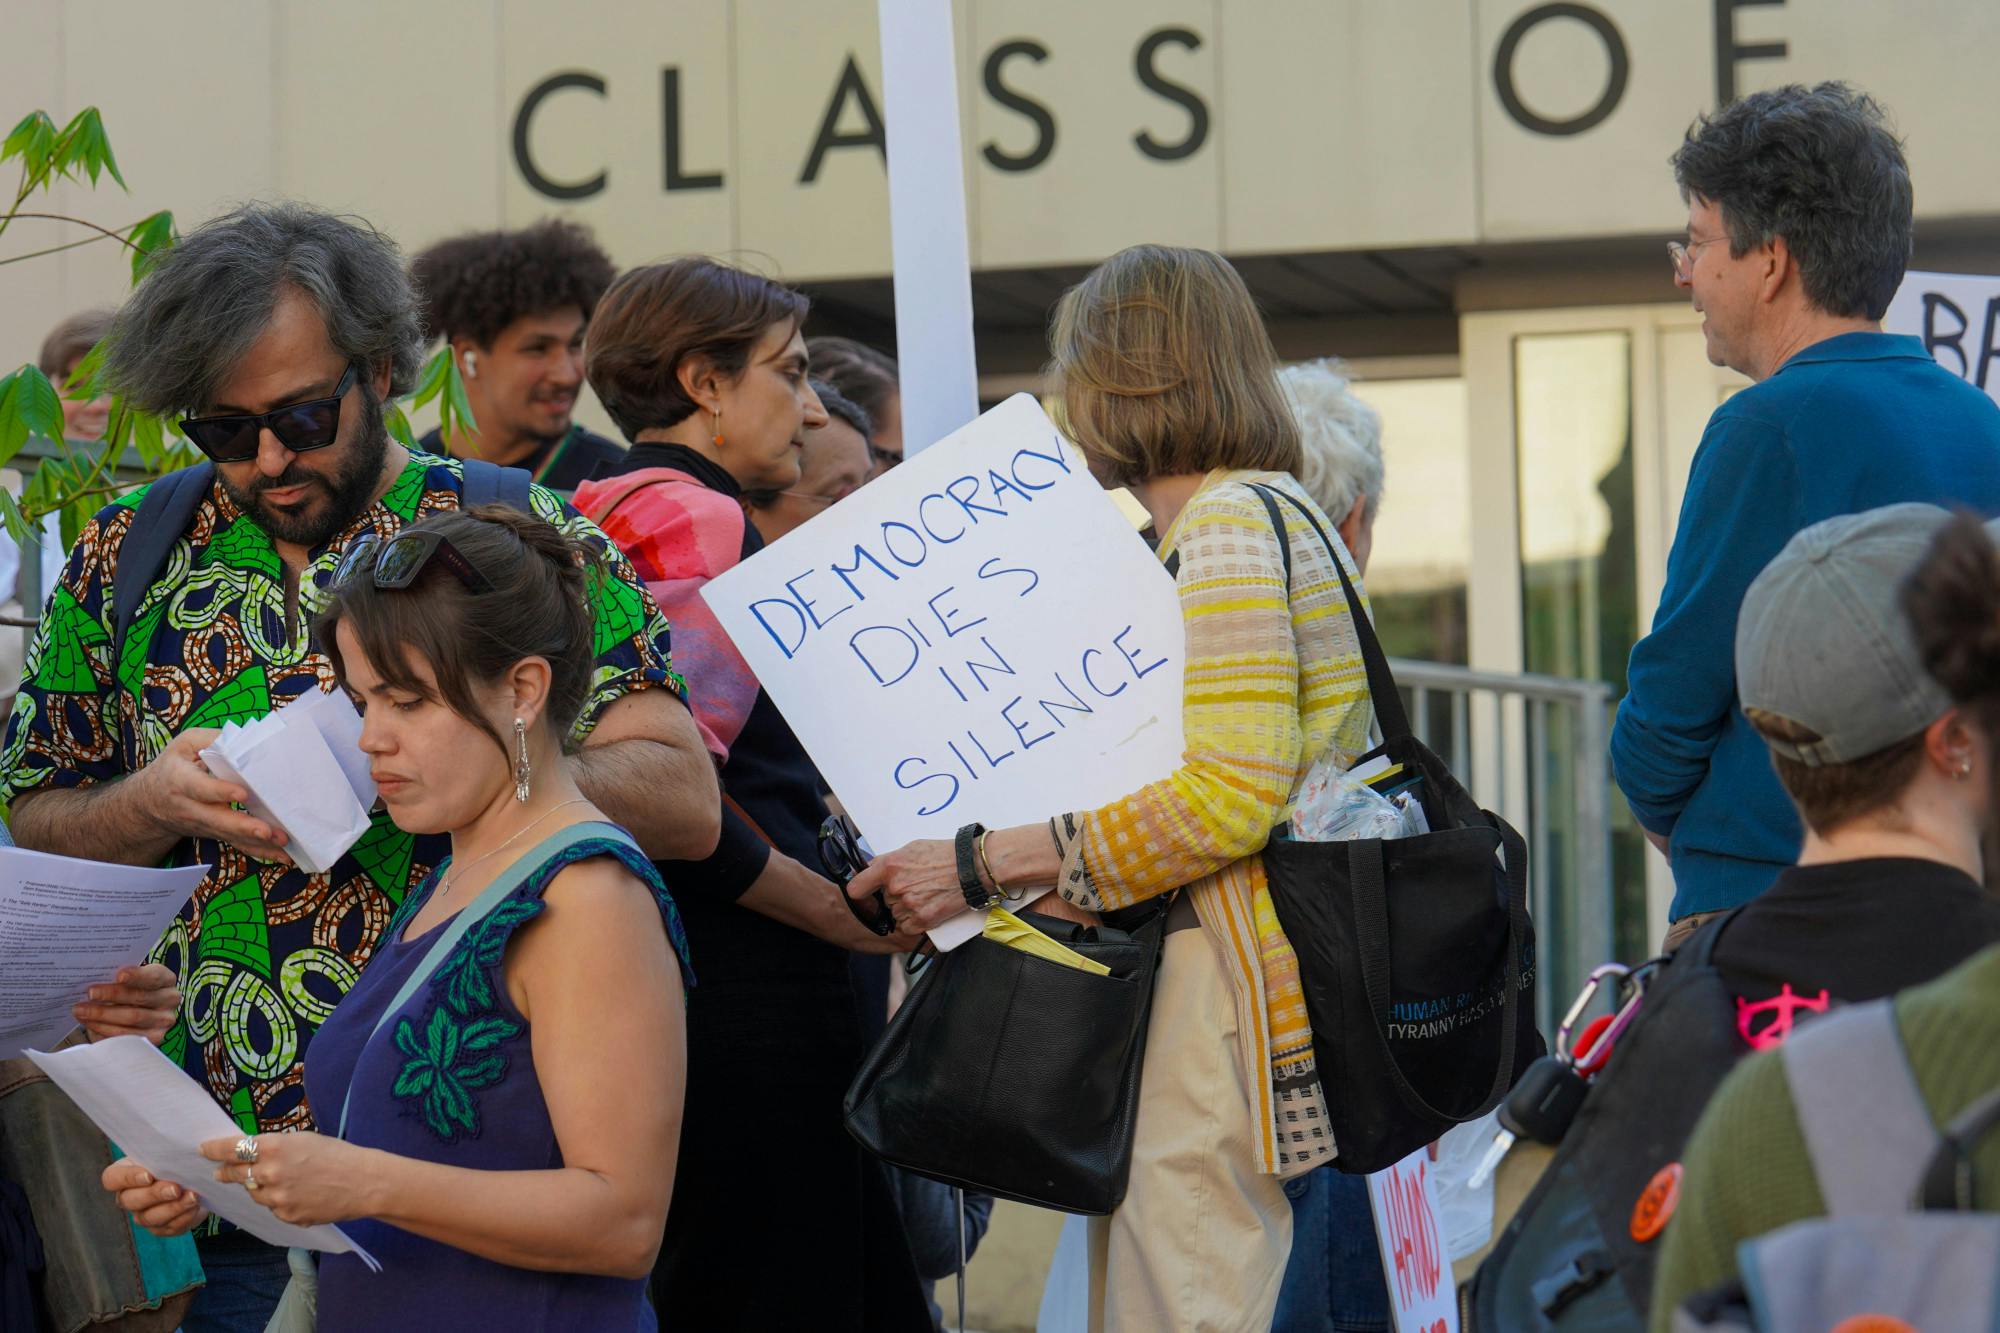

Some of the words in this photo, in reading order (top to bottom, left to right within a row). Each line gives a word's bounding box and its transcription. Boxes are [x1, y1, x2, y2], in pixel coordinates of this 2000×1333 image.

[511, 25, 1211, 201] CLASS
[1494, 0, 1788, 136] OF
[749, 436, 1071, 659] DEMOCRACY
[849, 557, 1039, 688] DIES
[938, 636, 1016, 702] IN
[894, 625, 1168, 816] SILENCE
[1388, 1016, 1456, 1040] TYRANNY
[1389, 997, 1450, 1022] HUMAN
